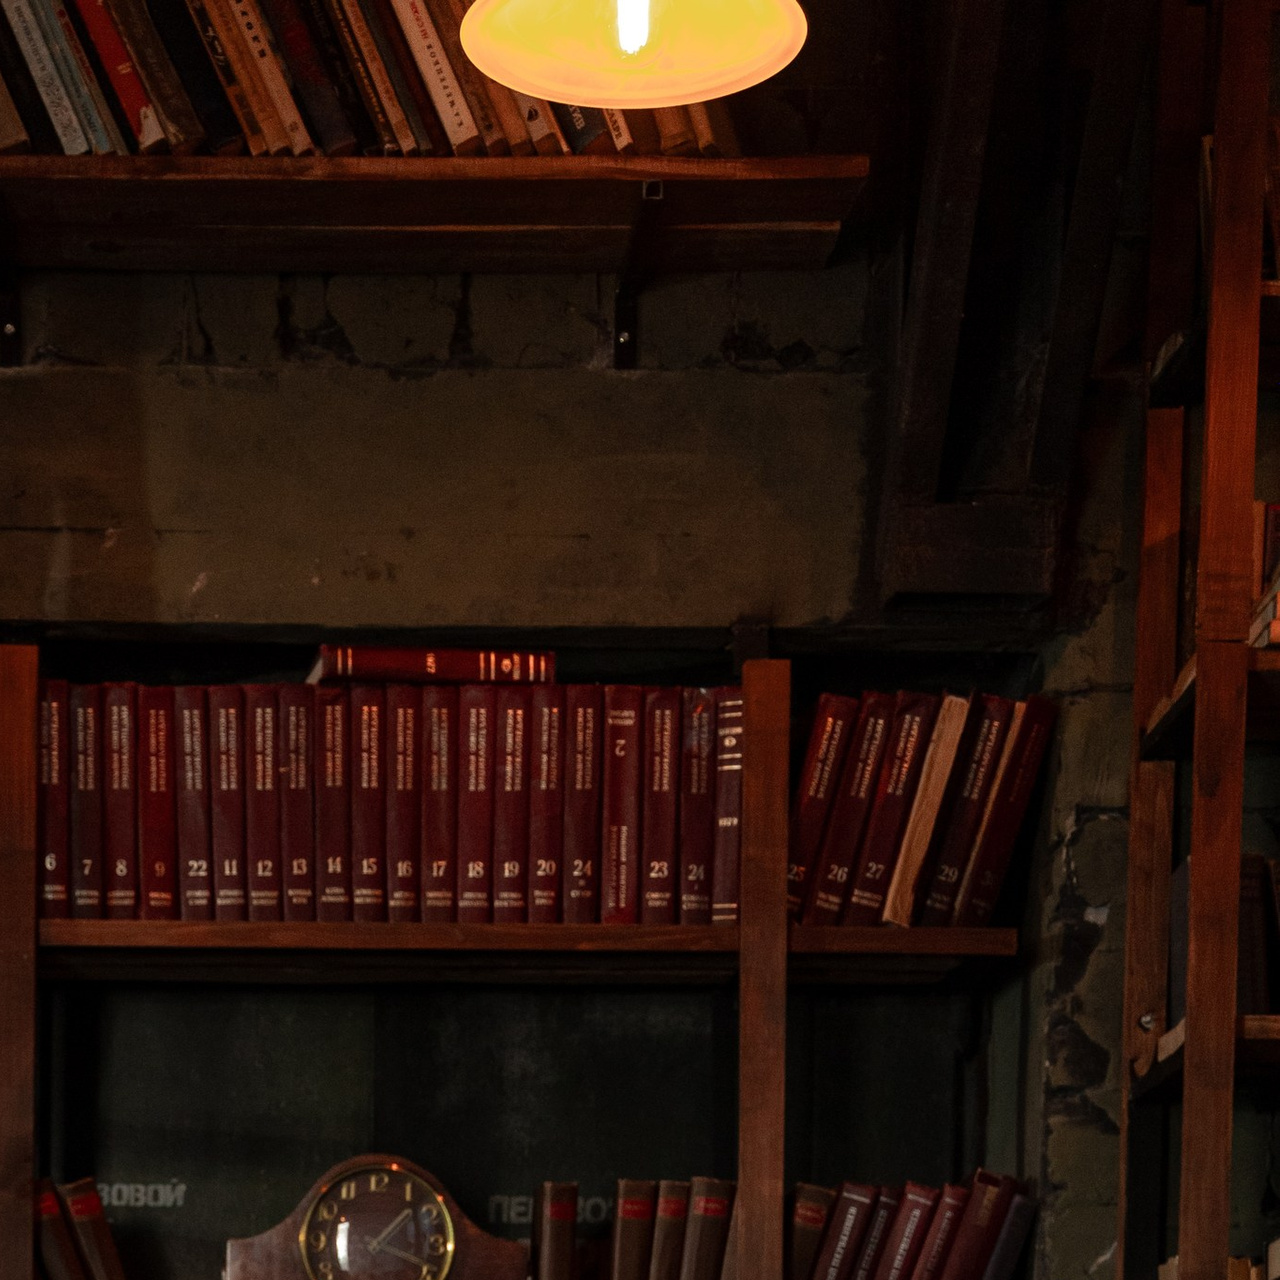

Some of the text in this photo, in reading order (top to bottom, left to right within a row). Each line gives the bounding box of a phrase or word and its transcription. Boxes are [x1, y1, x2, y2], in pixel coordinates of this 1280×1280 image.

[82, 858, 93, 876] 7
[115, 859, 128, 877] 8
[188, 860, 208, 877] 22
[257, 860, 273, 877] 12
[292, 858, 308, 875] 13
[327, 856, 342, 874] 14
[362, 857, 377, 875] 15
[397, 861, 412, 877] 16
[432, 860, 447, 877] 17
[467, 861, 484, 878] 18
[503, 861, 519, 878] 19
[536, 859, 556, 877] 20
[572, 858, 592, 877] 24
[649, 860, 668, 879] 23
[341, 1181, 356, 1200] 11
[369, 1173, 389, 1192] 12
[405, 1182, 412, 1202] 1
[310, 1231, 326, 1251] 9
[429, 1233, 446, 1256] 3
